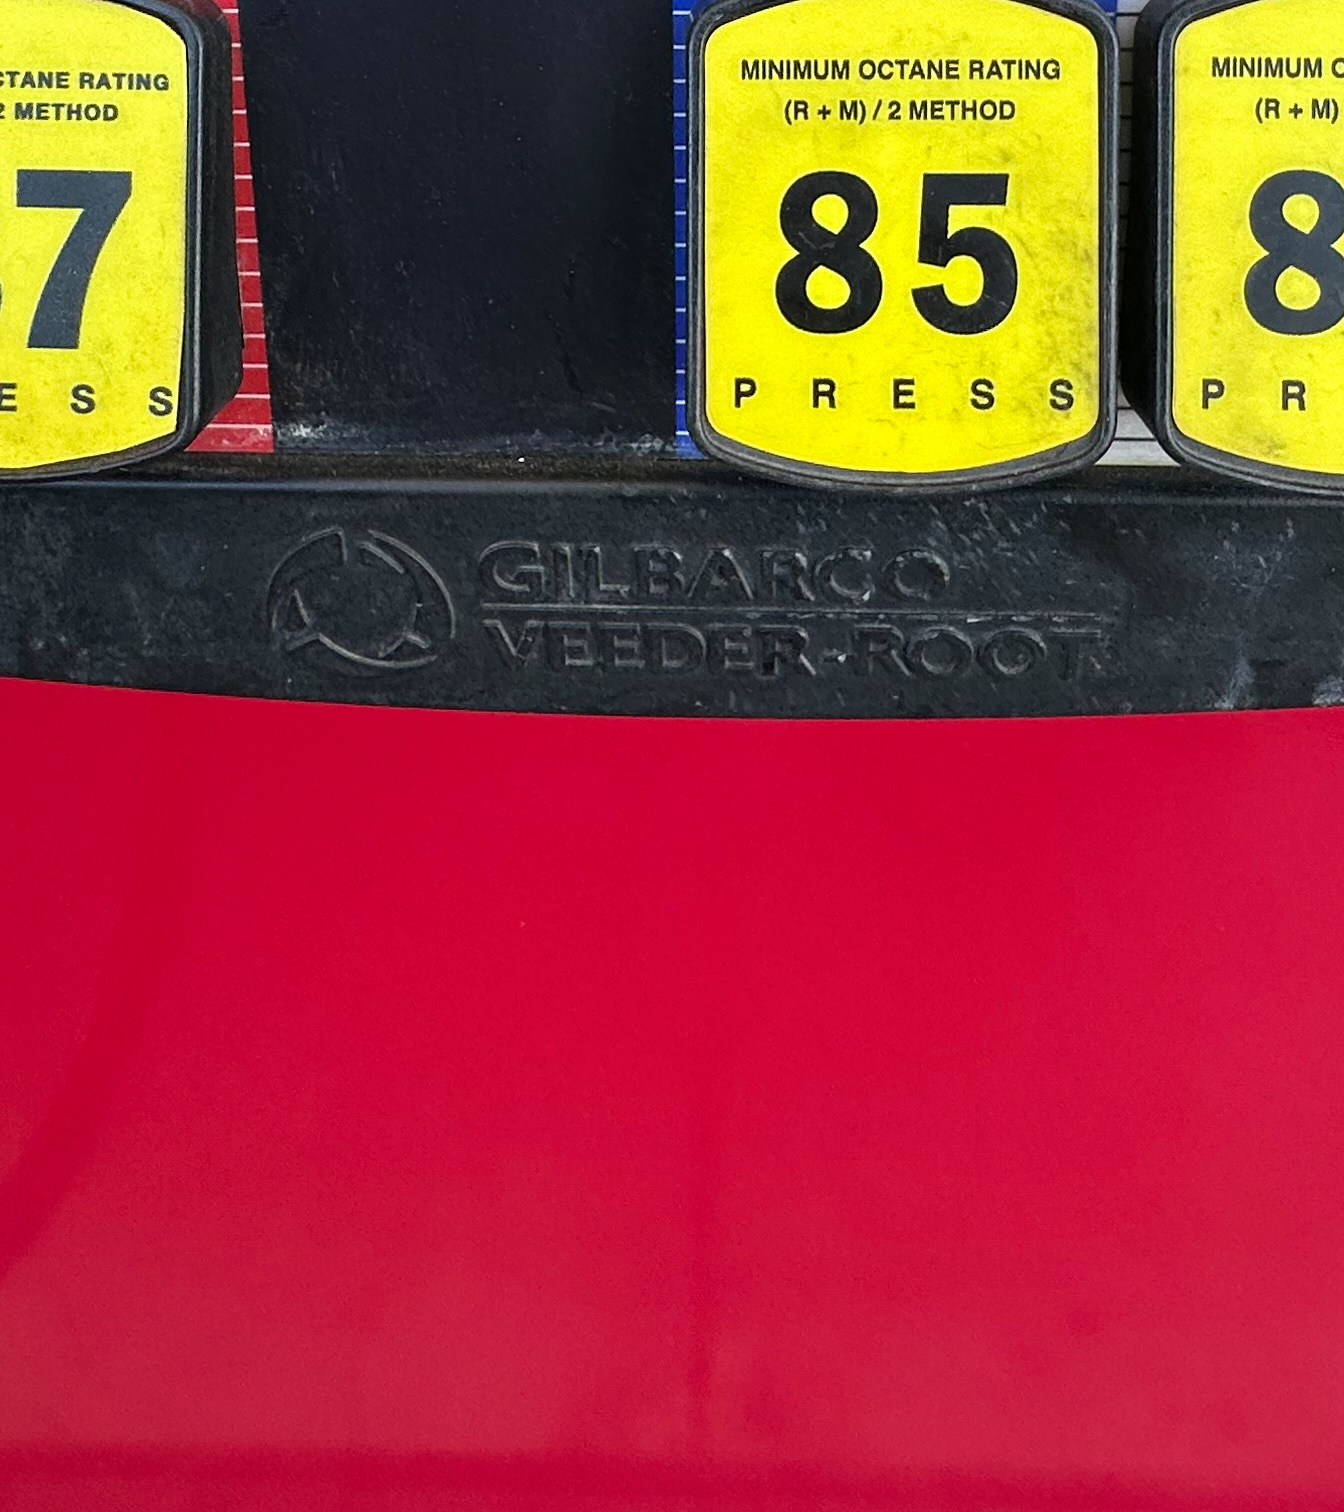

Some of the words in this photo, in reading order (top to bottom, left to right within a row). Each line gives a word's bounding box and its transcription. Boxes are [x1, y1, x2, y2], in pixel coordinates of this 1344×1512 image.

[741, 58, 850, 81] MINIMUM
[857, 58, 959, 81] OCTANE
[968, 58, 1061, 81] RATING
[1211, 56, 1323, 80] MINIMUM
[79, 71, 170, 93] RATING
[14, 101, 119, 123] METHOD
[888, 98, 902, 121] 2
[909, 98, 1016, 121] METHOD
[774, 169, 1019, 335] 85
[479, 540, 949, 601] GILBARCO
[482, 619, 1102, 679] VEEDER-ROOT
